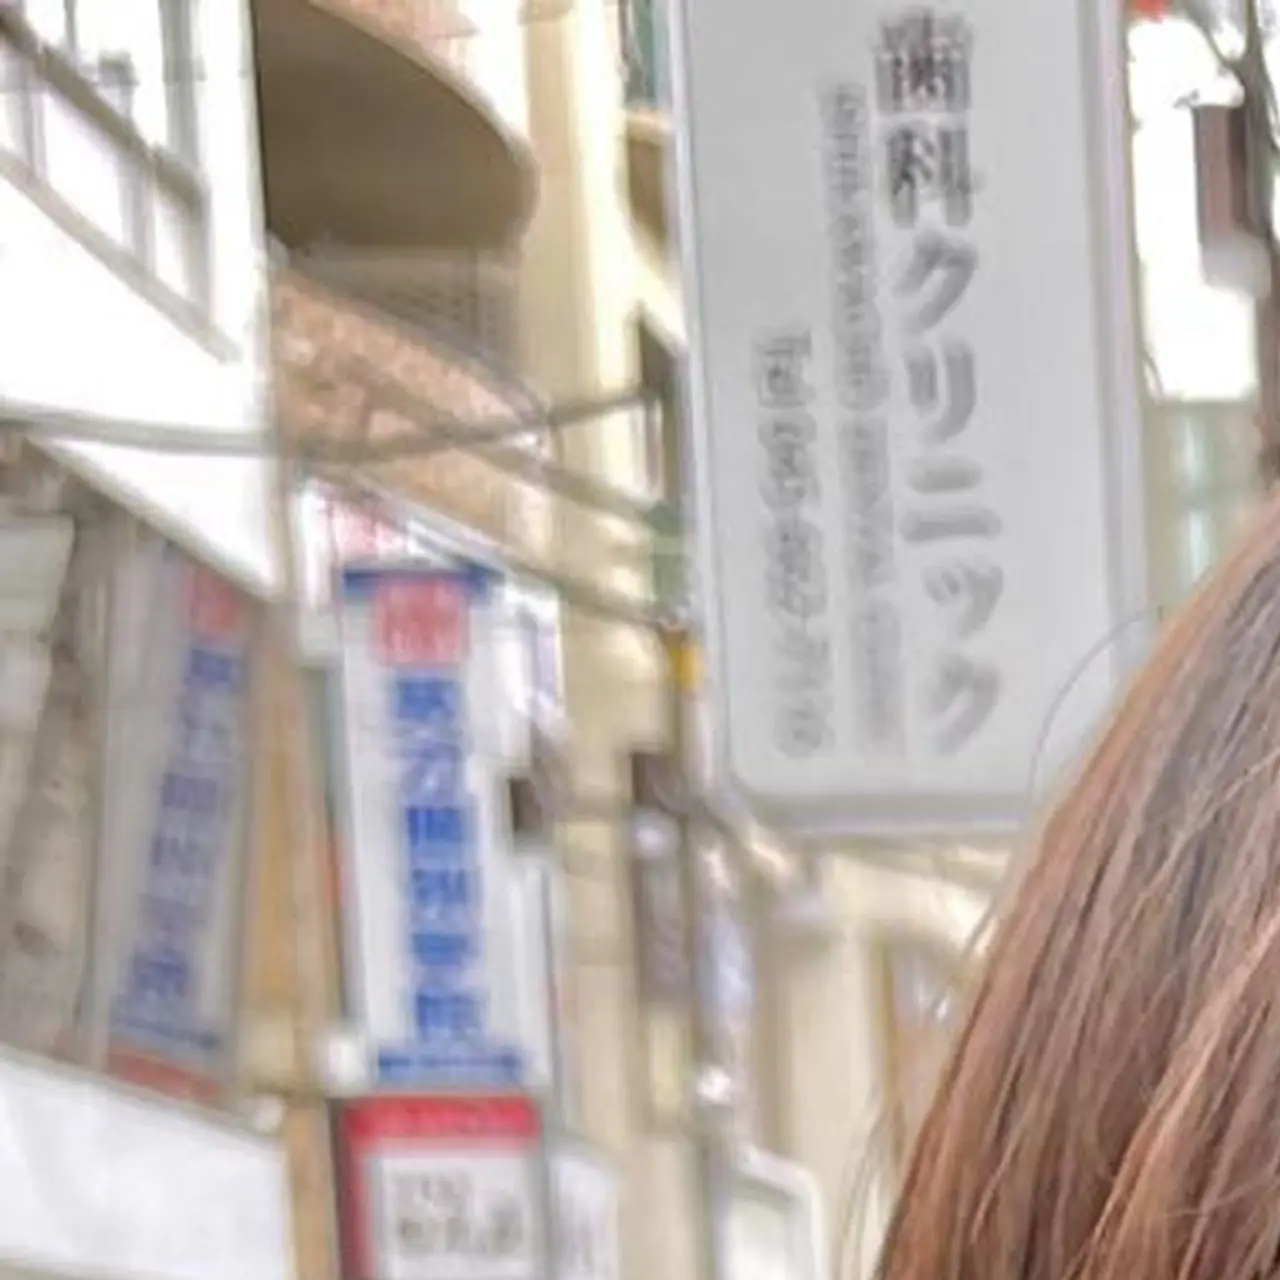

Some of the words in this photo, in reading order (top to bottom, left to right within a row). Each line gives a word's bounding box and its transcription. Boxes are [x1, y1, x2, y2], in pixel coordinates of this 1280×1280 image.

[874, 8, 1003, 758] 歯科クリニック
